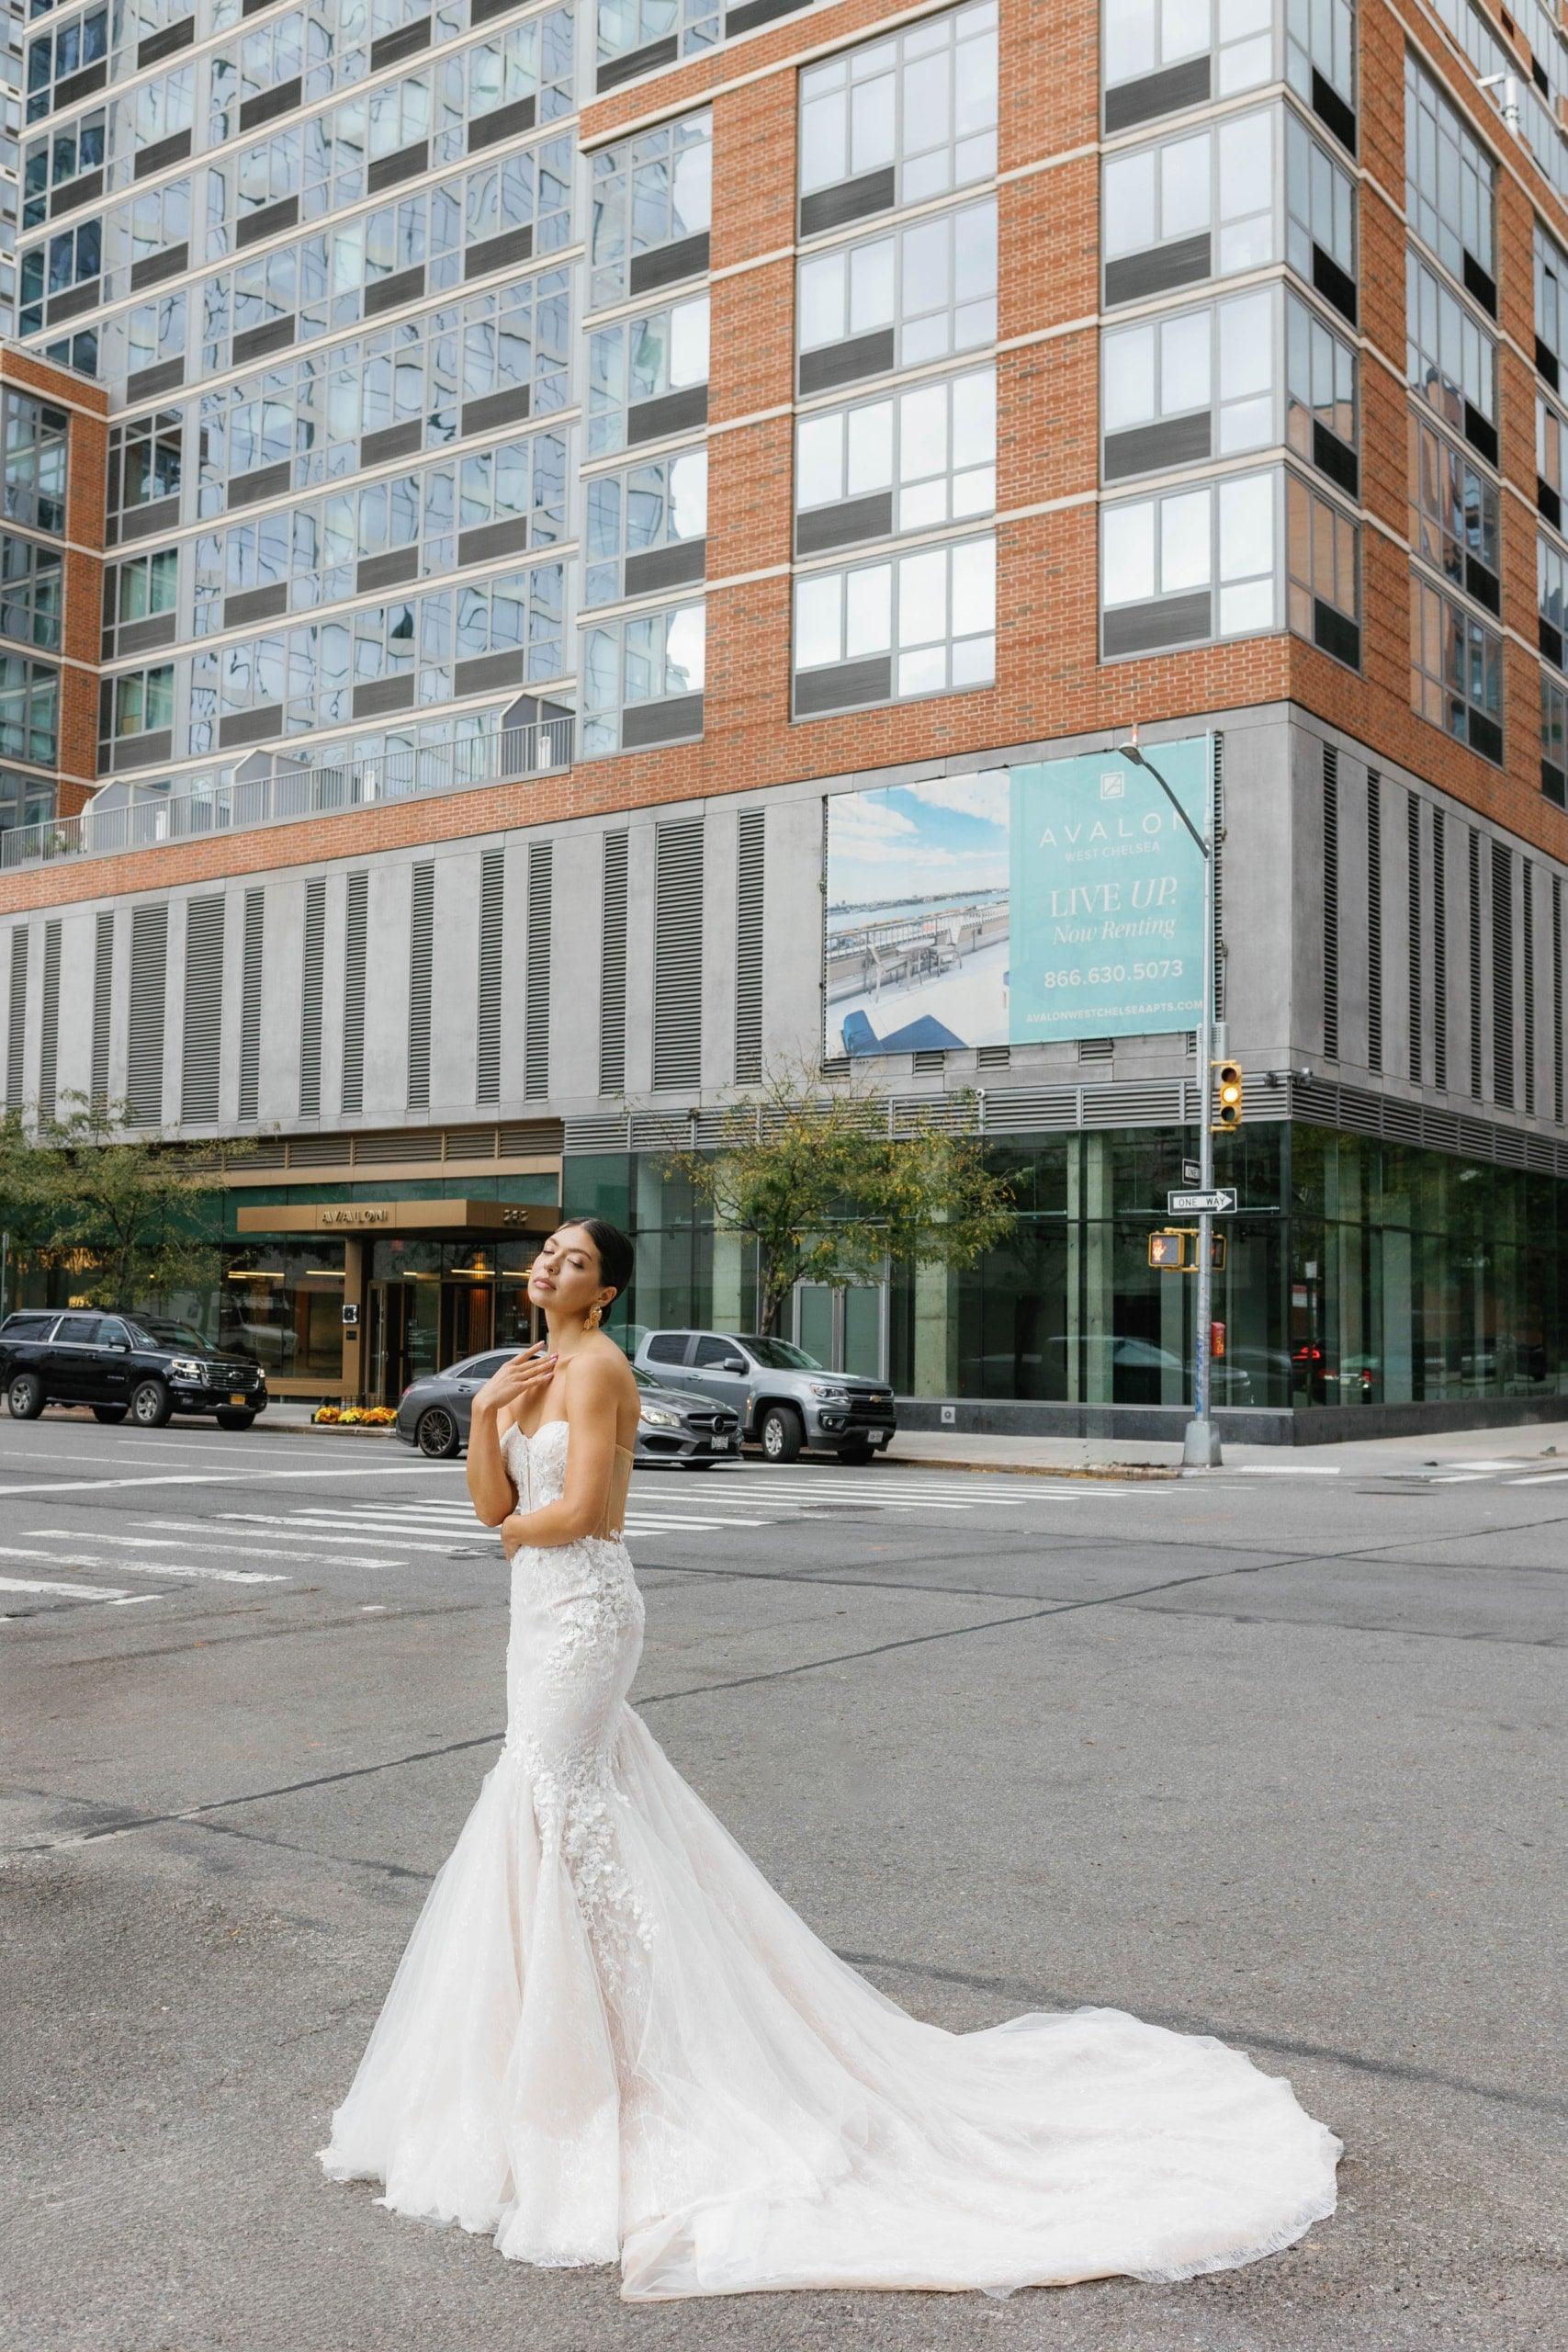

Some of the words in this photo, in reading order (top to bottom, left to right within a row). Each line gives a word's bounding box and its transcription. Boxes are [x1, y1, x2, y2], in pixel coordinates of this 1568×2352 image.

[1066, 849, 1099, 862] WEST
[1102, 841, 1160, 858] CHELSEA
[1050, 883, 1122, 918] LIVE
[1131, 876, 1178, 910] UP.
[1053, 924, 1098, 945] Now
[1101, 917, 1178, 941] Renting
[1043, 959, 1184, 989] 866.630.5073
[1026, 1000, 1204, 1023] AVALONWESTCHELSEAAPTS.COM
[1179, 1197, 1198, 1207] ONE
[1206, 1197, 1225, 1206] WAY
[321, 1209, 389, 1223] AVALON
